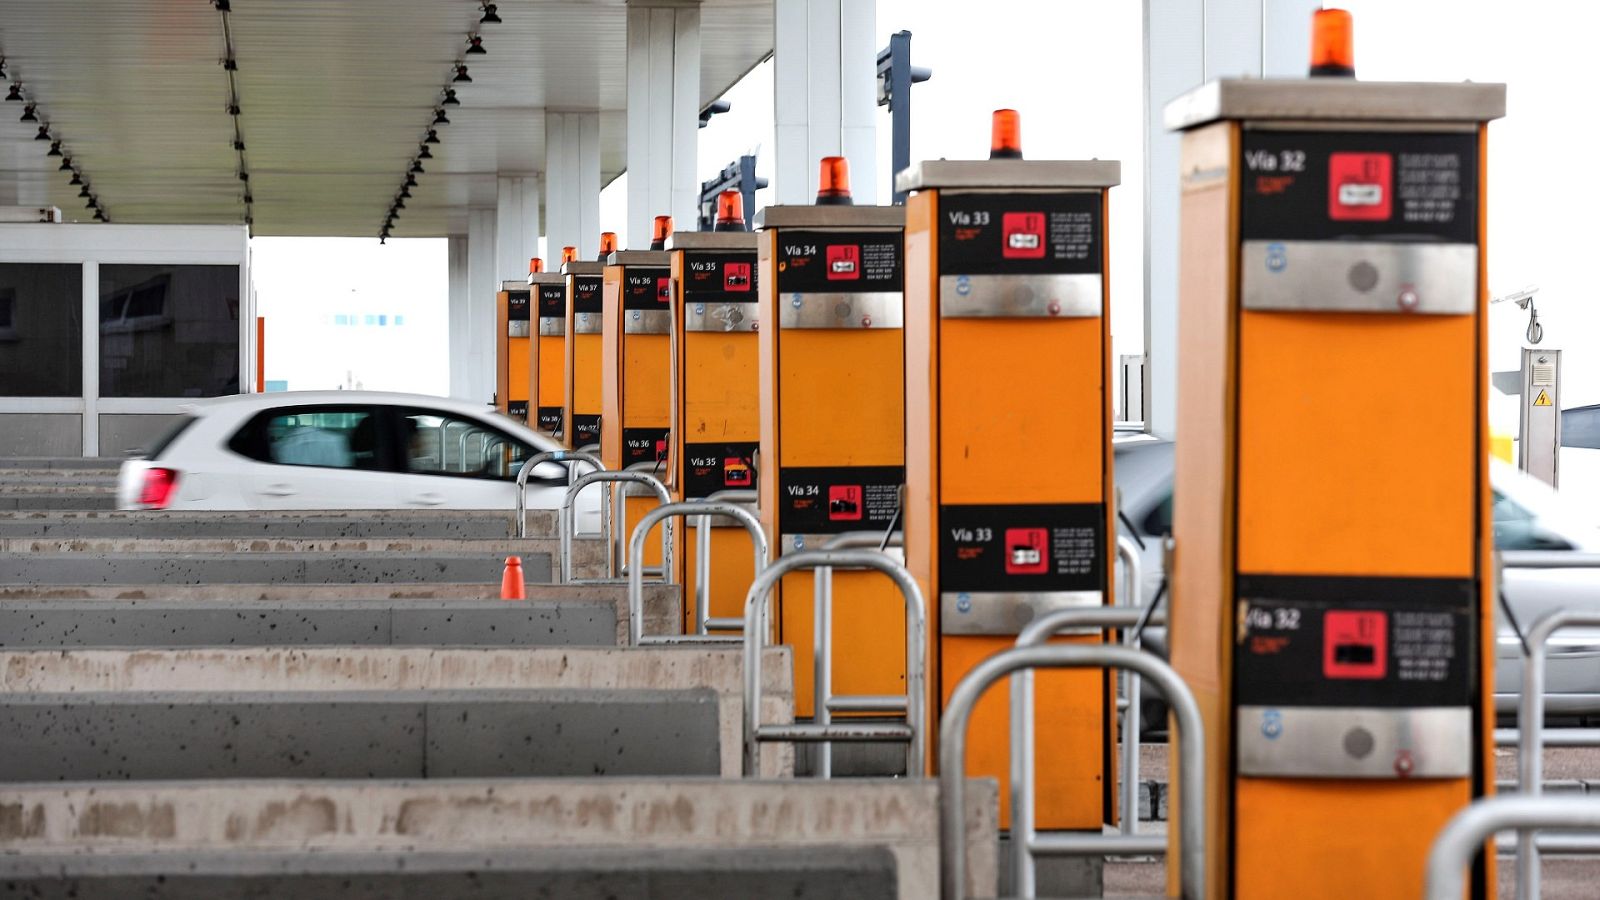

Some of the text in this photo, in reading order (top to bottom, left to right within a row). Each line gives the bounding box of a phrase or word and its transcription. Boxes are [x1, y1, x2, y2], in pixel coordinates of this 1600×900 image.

[1280, 150, 1306, 172] 32
[973, 211, 990, 226] 33
[803, 245, 816, 256] 34
[705, 262, 716, 271] 35
[641, 277, 651, 285] 36
[640, 440, 650, 448] 36
[705, 457, 716, 466] 35
[806, 485, 819, 496] 34
[975, 528, 992, 542] 33
[1274, 609, 1301, 629] 32
